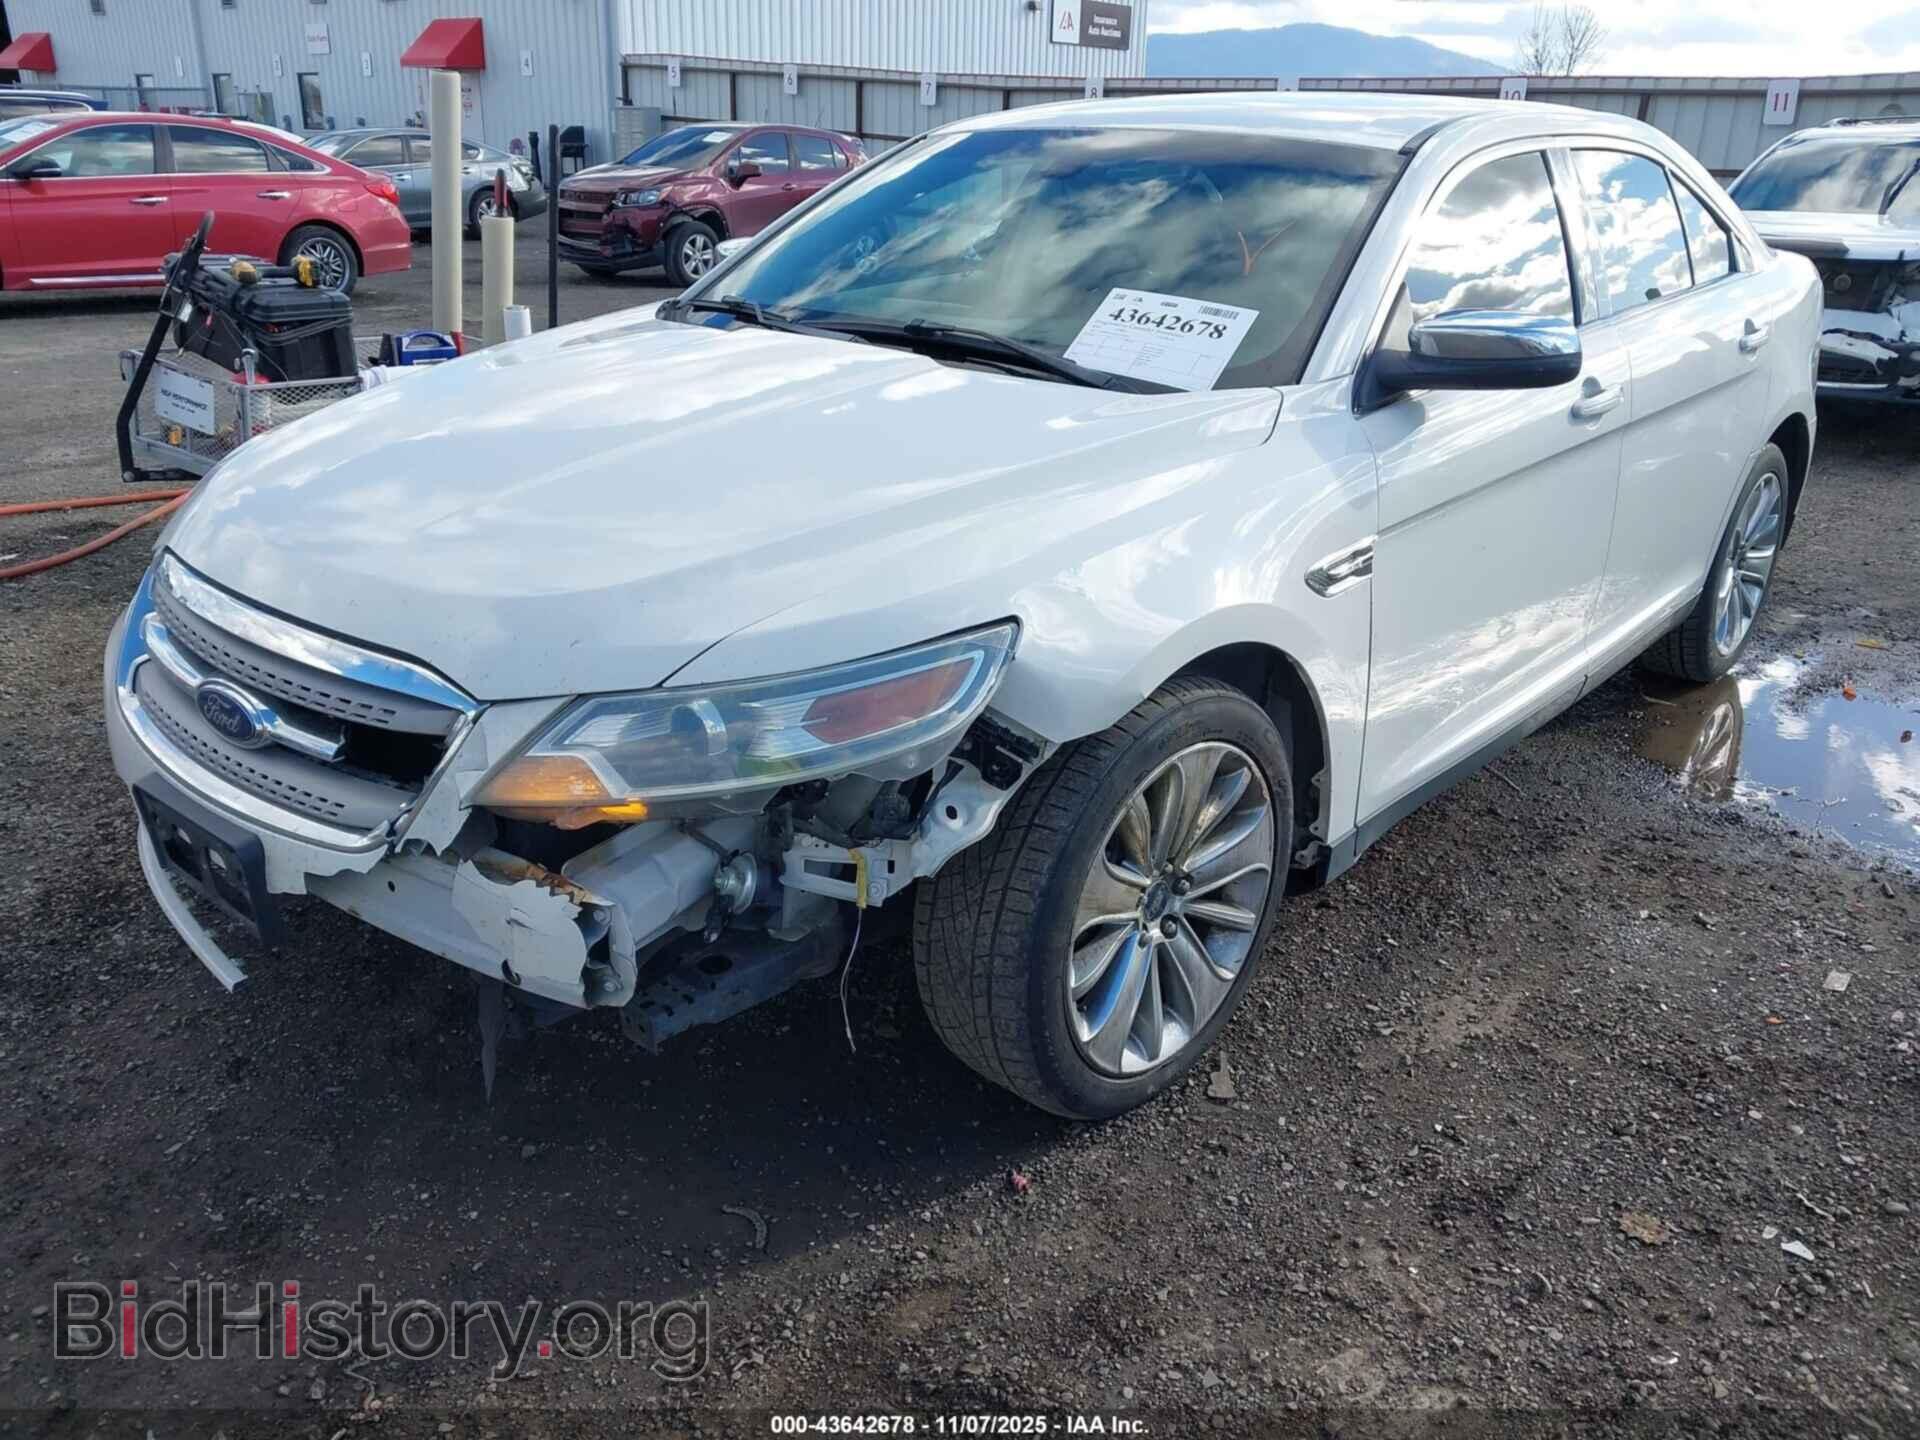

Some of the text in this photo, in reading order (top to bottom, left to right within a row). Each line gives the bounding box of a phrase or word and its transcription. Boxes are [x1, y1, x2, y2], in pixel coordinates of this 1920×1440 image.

[523, 57, 530, 68] 4
[671, 66, 678, 79] 5
[786, 74, 793, 86] 6
[923, 82, 932, 95] 7
[1773, 92, 1789, 112] 11
[1109, 307, 1227, 339] 43642678
[203, 694, 241, 733] Ford
